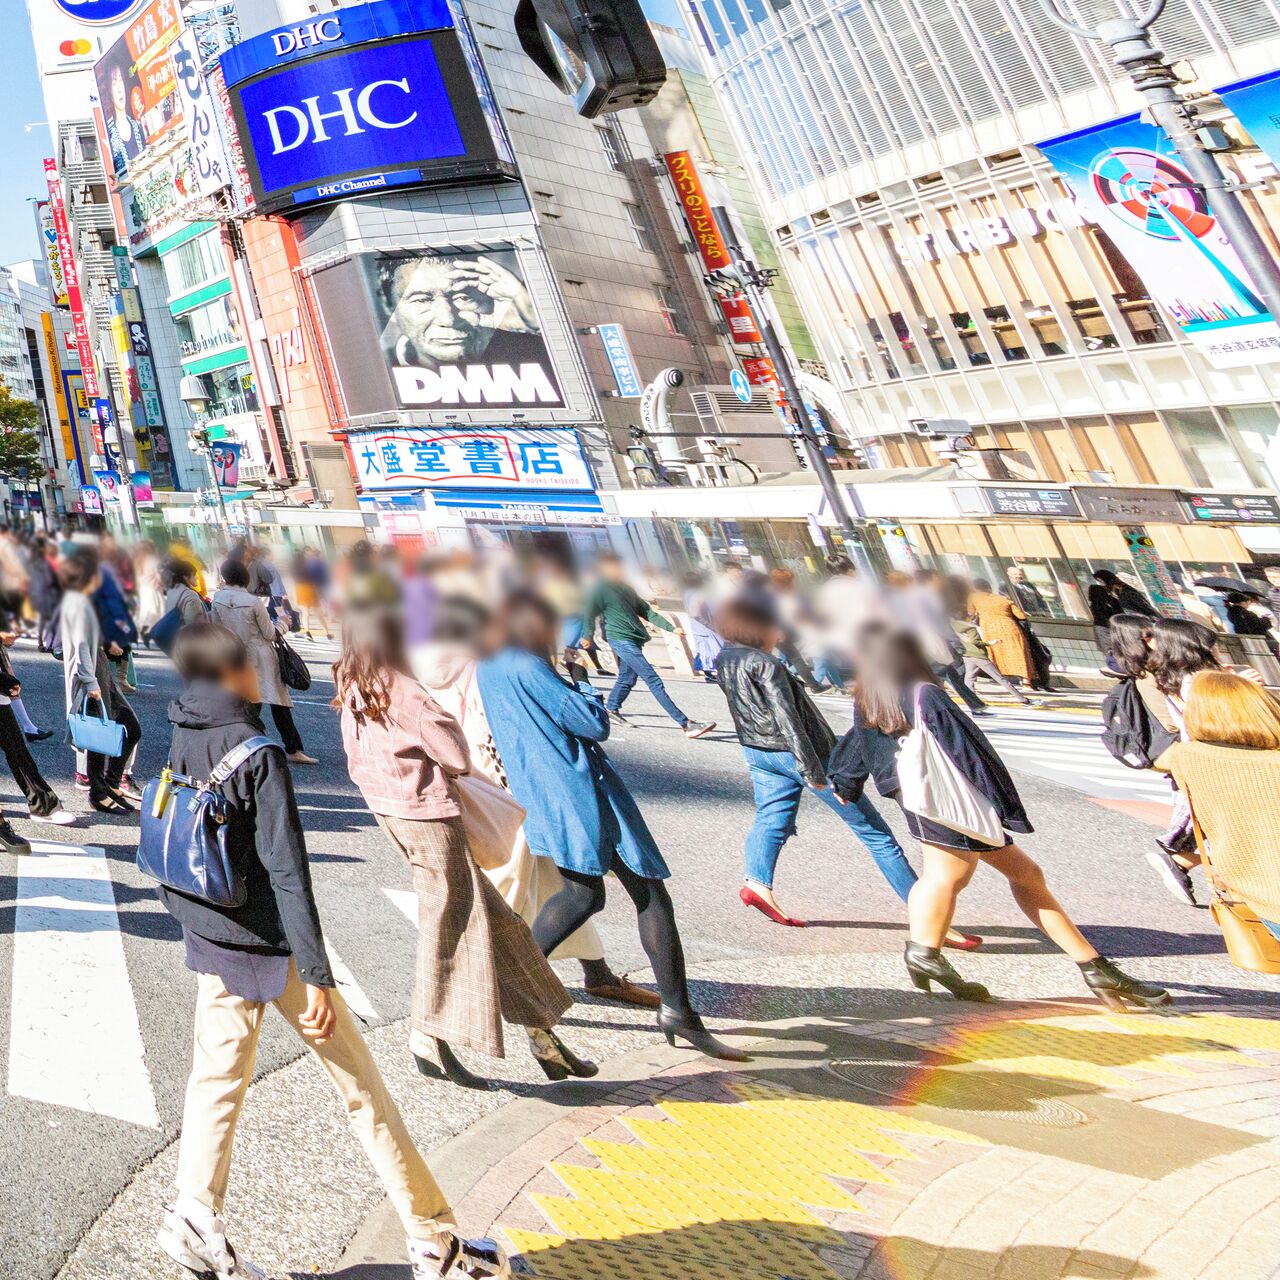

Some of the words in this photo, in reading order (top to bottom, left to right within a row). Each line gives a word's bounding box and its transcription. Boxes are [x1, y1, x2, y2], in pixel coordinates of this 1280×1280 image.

[271, 17, 344, 57] DHC
[173, 38, 223, 184] もんじゃ
[262, 76, 419, 156] DHC
[316, 184, 343, 198] DHC
[343, 175, 388, 193] Channel
[670, 156, 723, 260] クスリのことなら
[50, 360, 63, 395] Matsumoto
[391, 362, 561, 406] DMM
[361, 439, 564, 475] 大盛堂書店
[549, 477, 580, 485] TAISEIDO
[500, 503, 549, 511] TAISEIDO
[997, 498, 1043, 513] 渋谷駅
